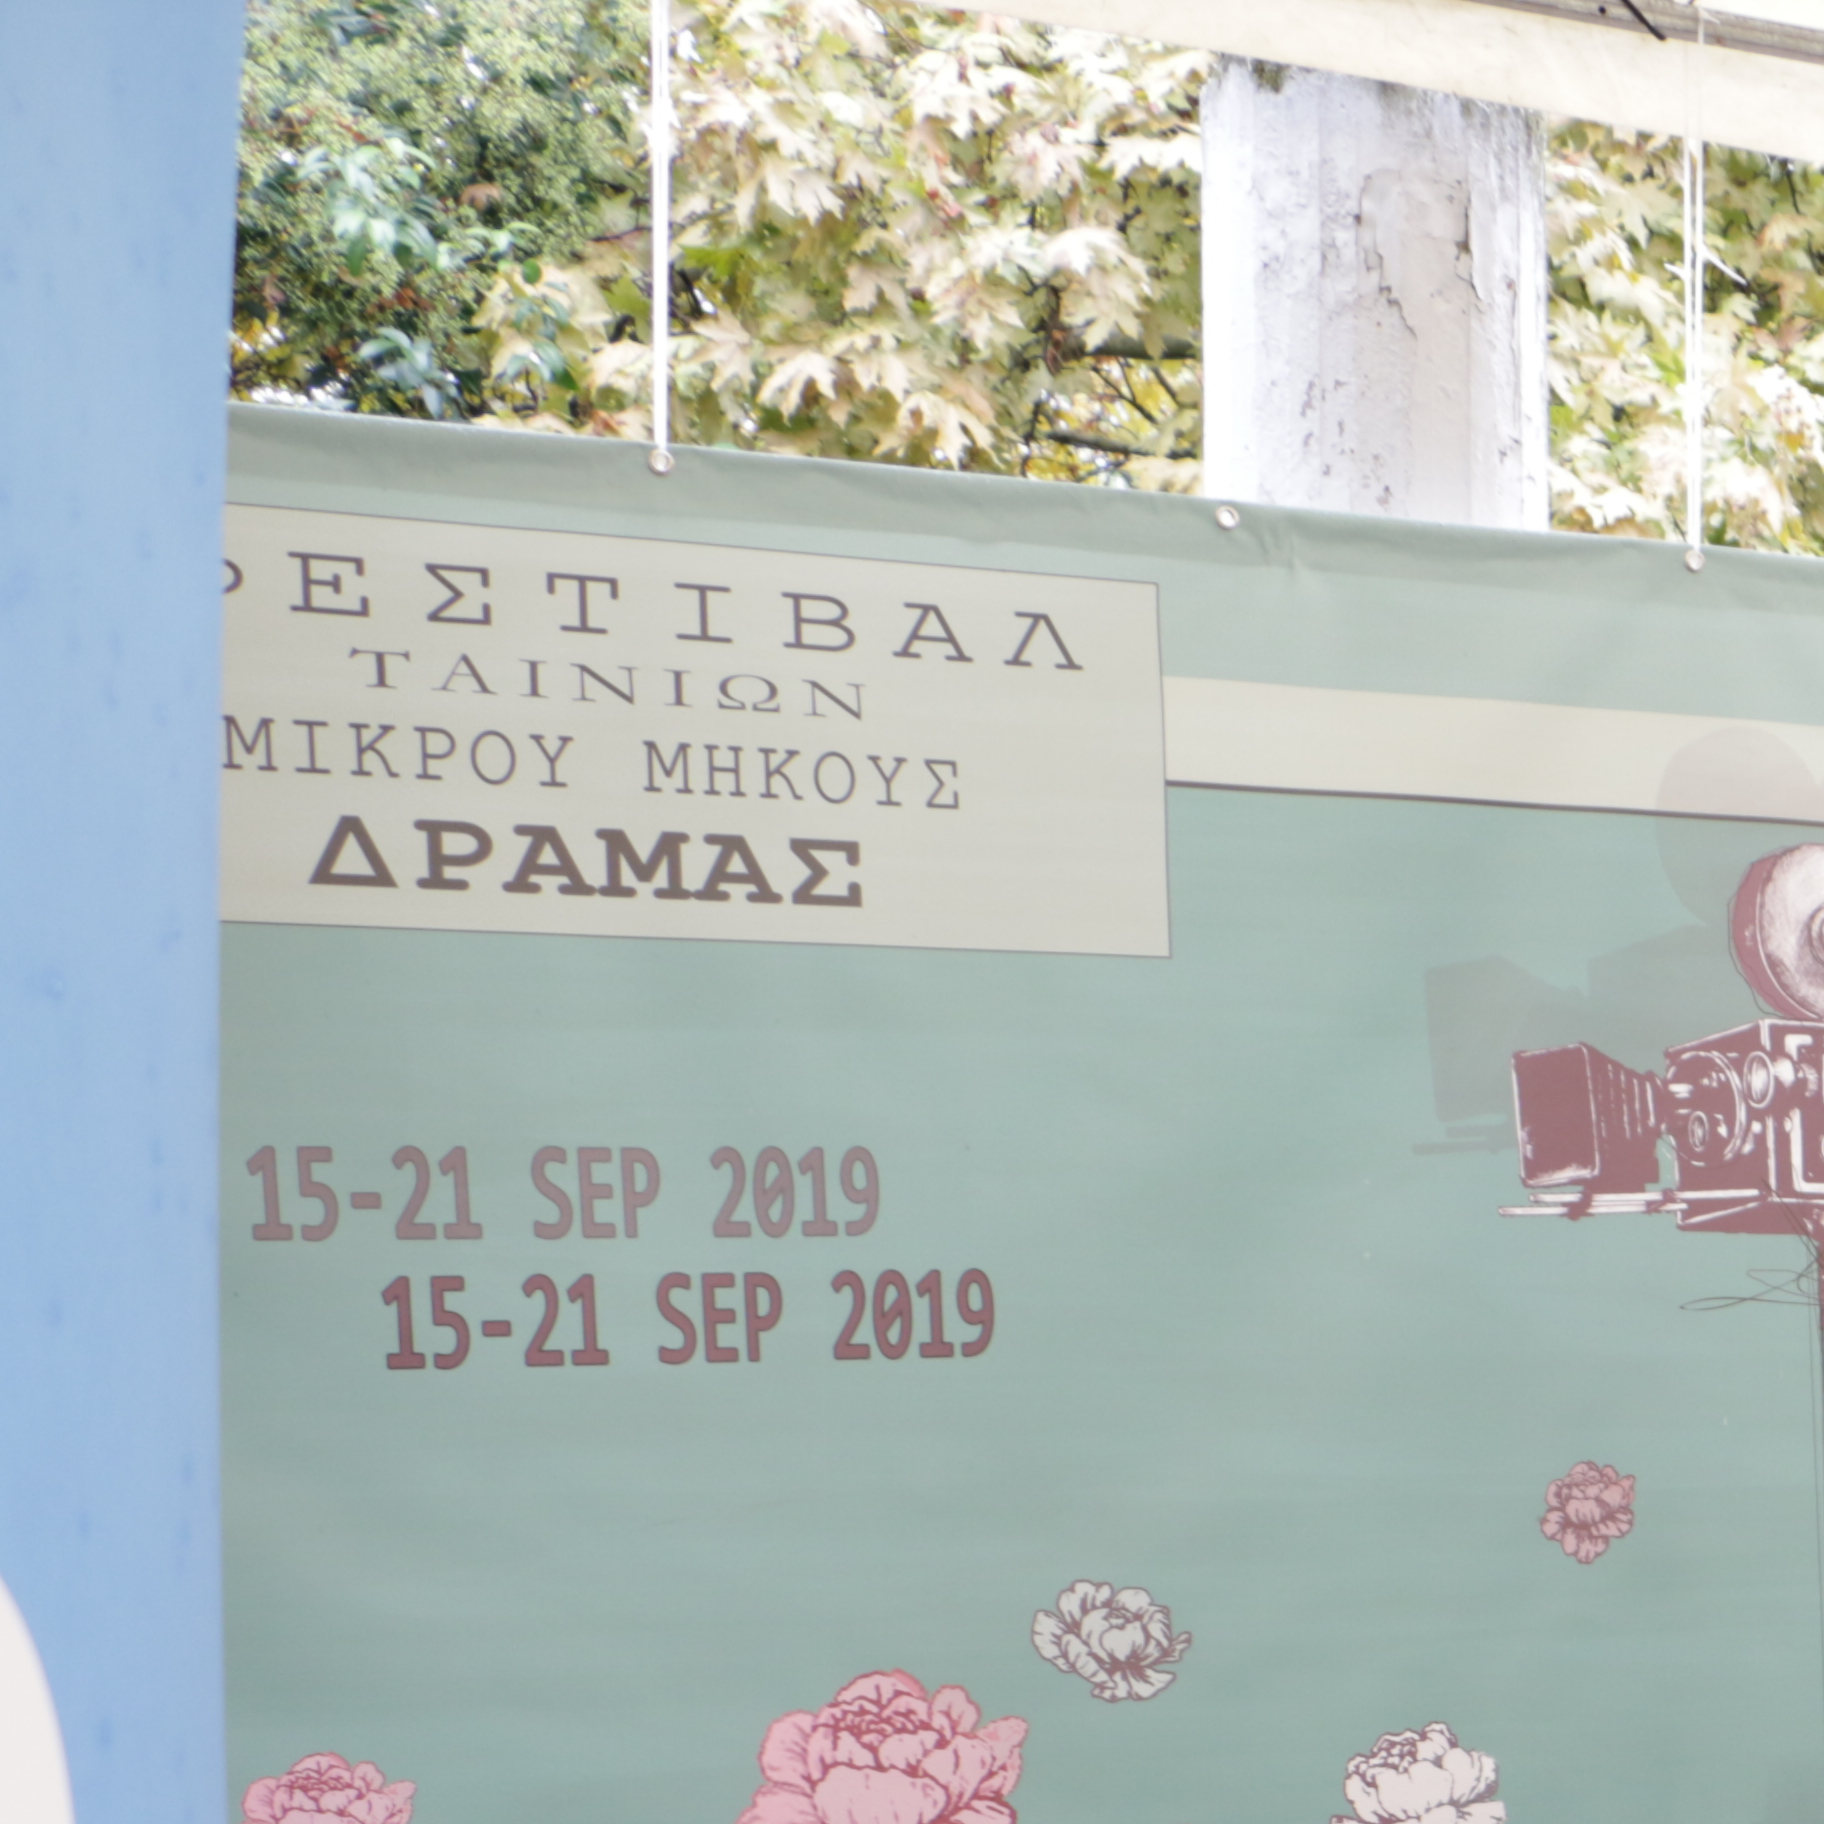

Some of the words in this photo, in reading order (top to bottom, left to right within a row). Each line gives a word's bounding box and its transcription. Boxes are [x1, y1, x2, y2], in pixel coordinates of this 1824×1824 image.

[348, 645, 867, 722] ΤΑΙΝΙΩΝ
[222, 713, 575, 790] ΜΙΚΡΟΥ
[642, 738, 961, 811] ΜΗΚΟΥΣ
[308, 813, 864, 908] ΔΡΑΜΑΣ
[245, 1145, 483, 1242] 15-21
[530, 1147, 662, 1239] SEP
[708, 1144, 881, 1237] 2019
[381, 1273, 611, 1370] 15-21
[655, 1271, 783, 1364] SEP
[830, 1266, 996, 1361] 2019
